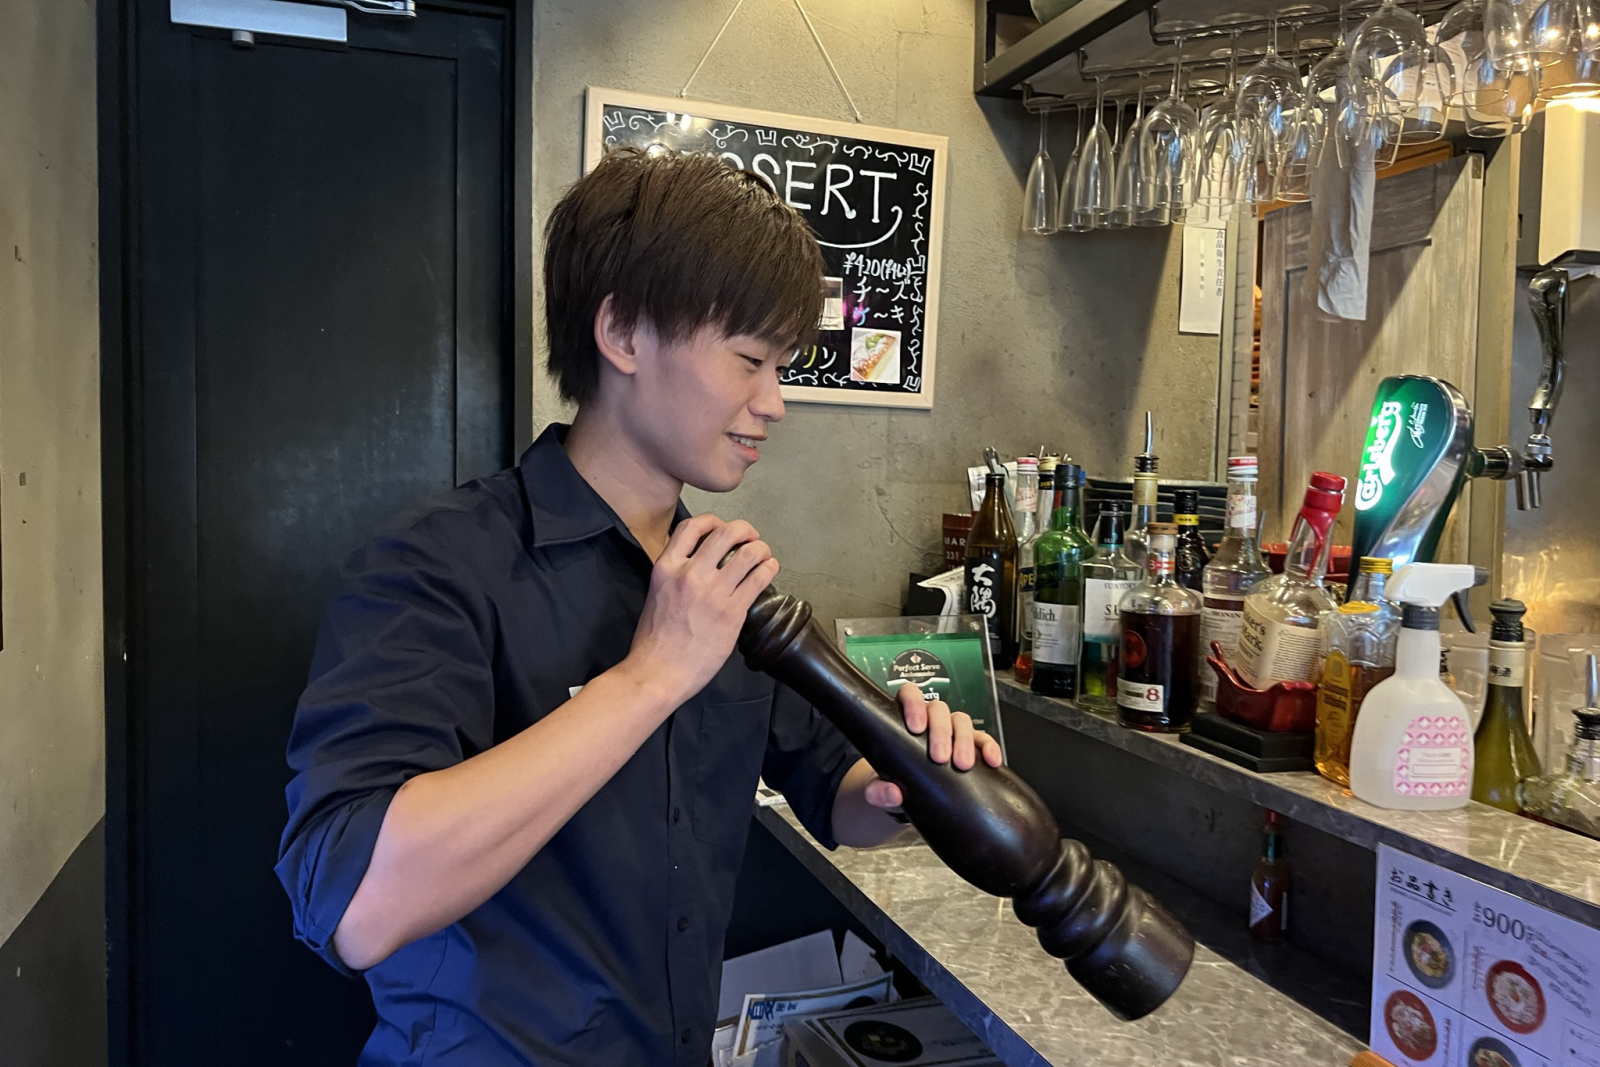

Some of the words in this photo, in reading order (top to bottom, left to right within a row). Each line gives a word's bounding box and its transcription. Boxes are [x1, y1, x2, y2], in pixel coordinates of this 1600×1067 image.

[721, 152, 898, 224] SERT
[1355, 401, 1402, 511] Carlsberg
[893, 664, 920, 673] Perfect
[920, 663, 941, 671] Serve
[1145, 687, 1161, 702] 8
[1390, 867, 1454, 907] お品書き
[1482, 907, 1525, 941] 900
